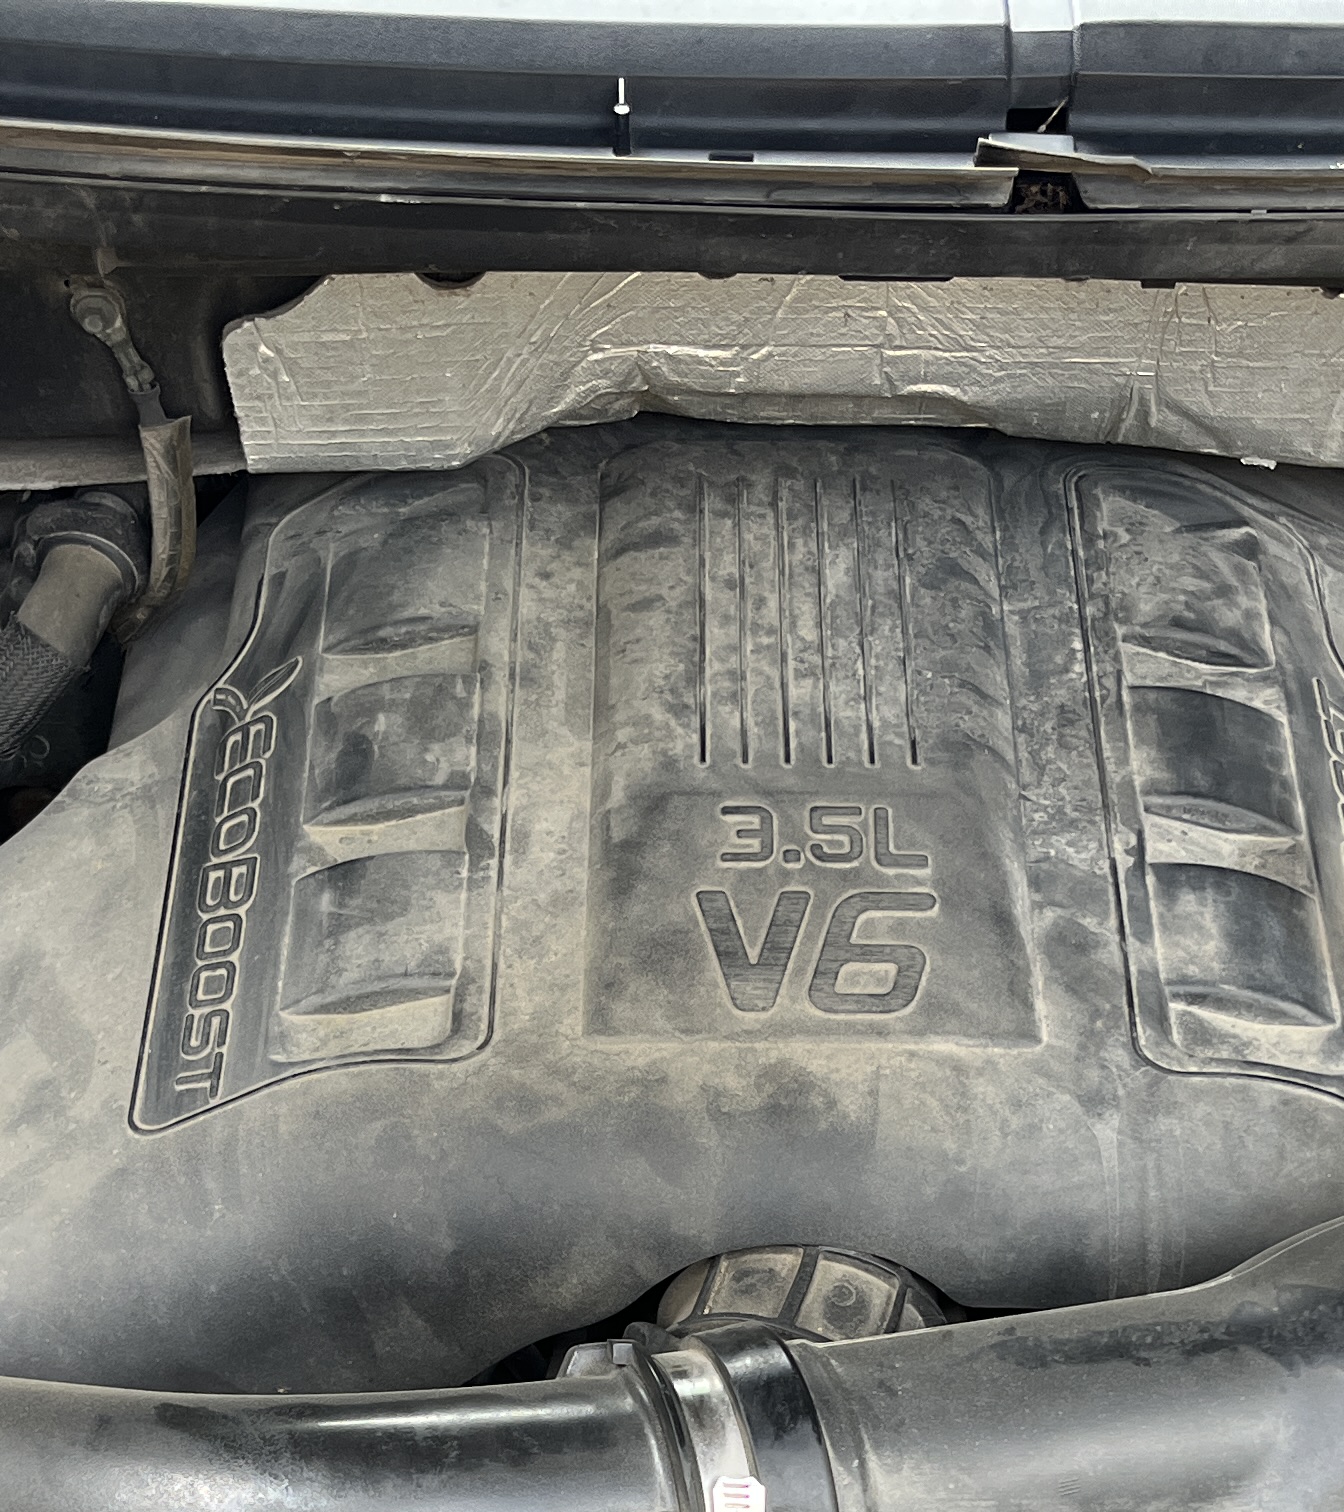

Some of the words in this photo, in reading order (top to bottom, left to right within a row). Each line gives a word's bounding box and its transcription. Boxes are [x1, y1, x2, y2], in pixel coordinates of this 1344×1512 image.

[716, 803, 933, 873] 3.5L
[175, 713, 276, 1104] ECOBOOST
[693, 888, 938, 1017] V6
